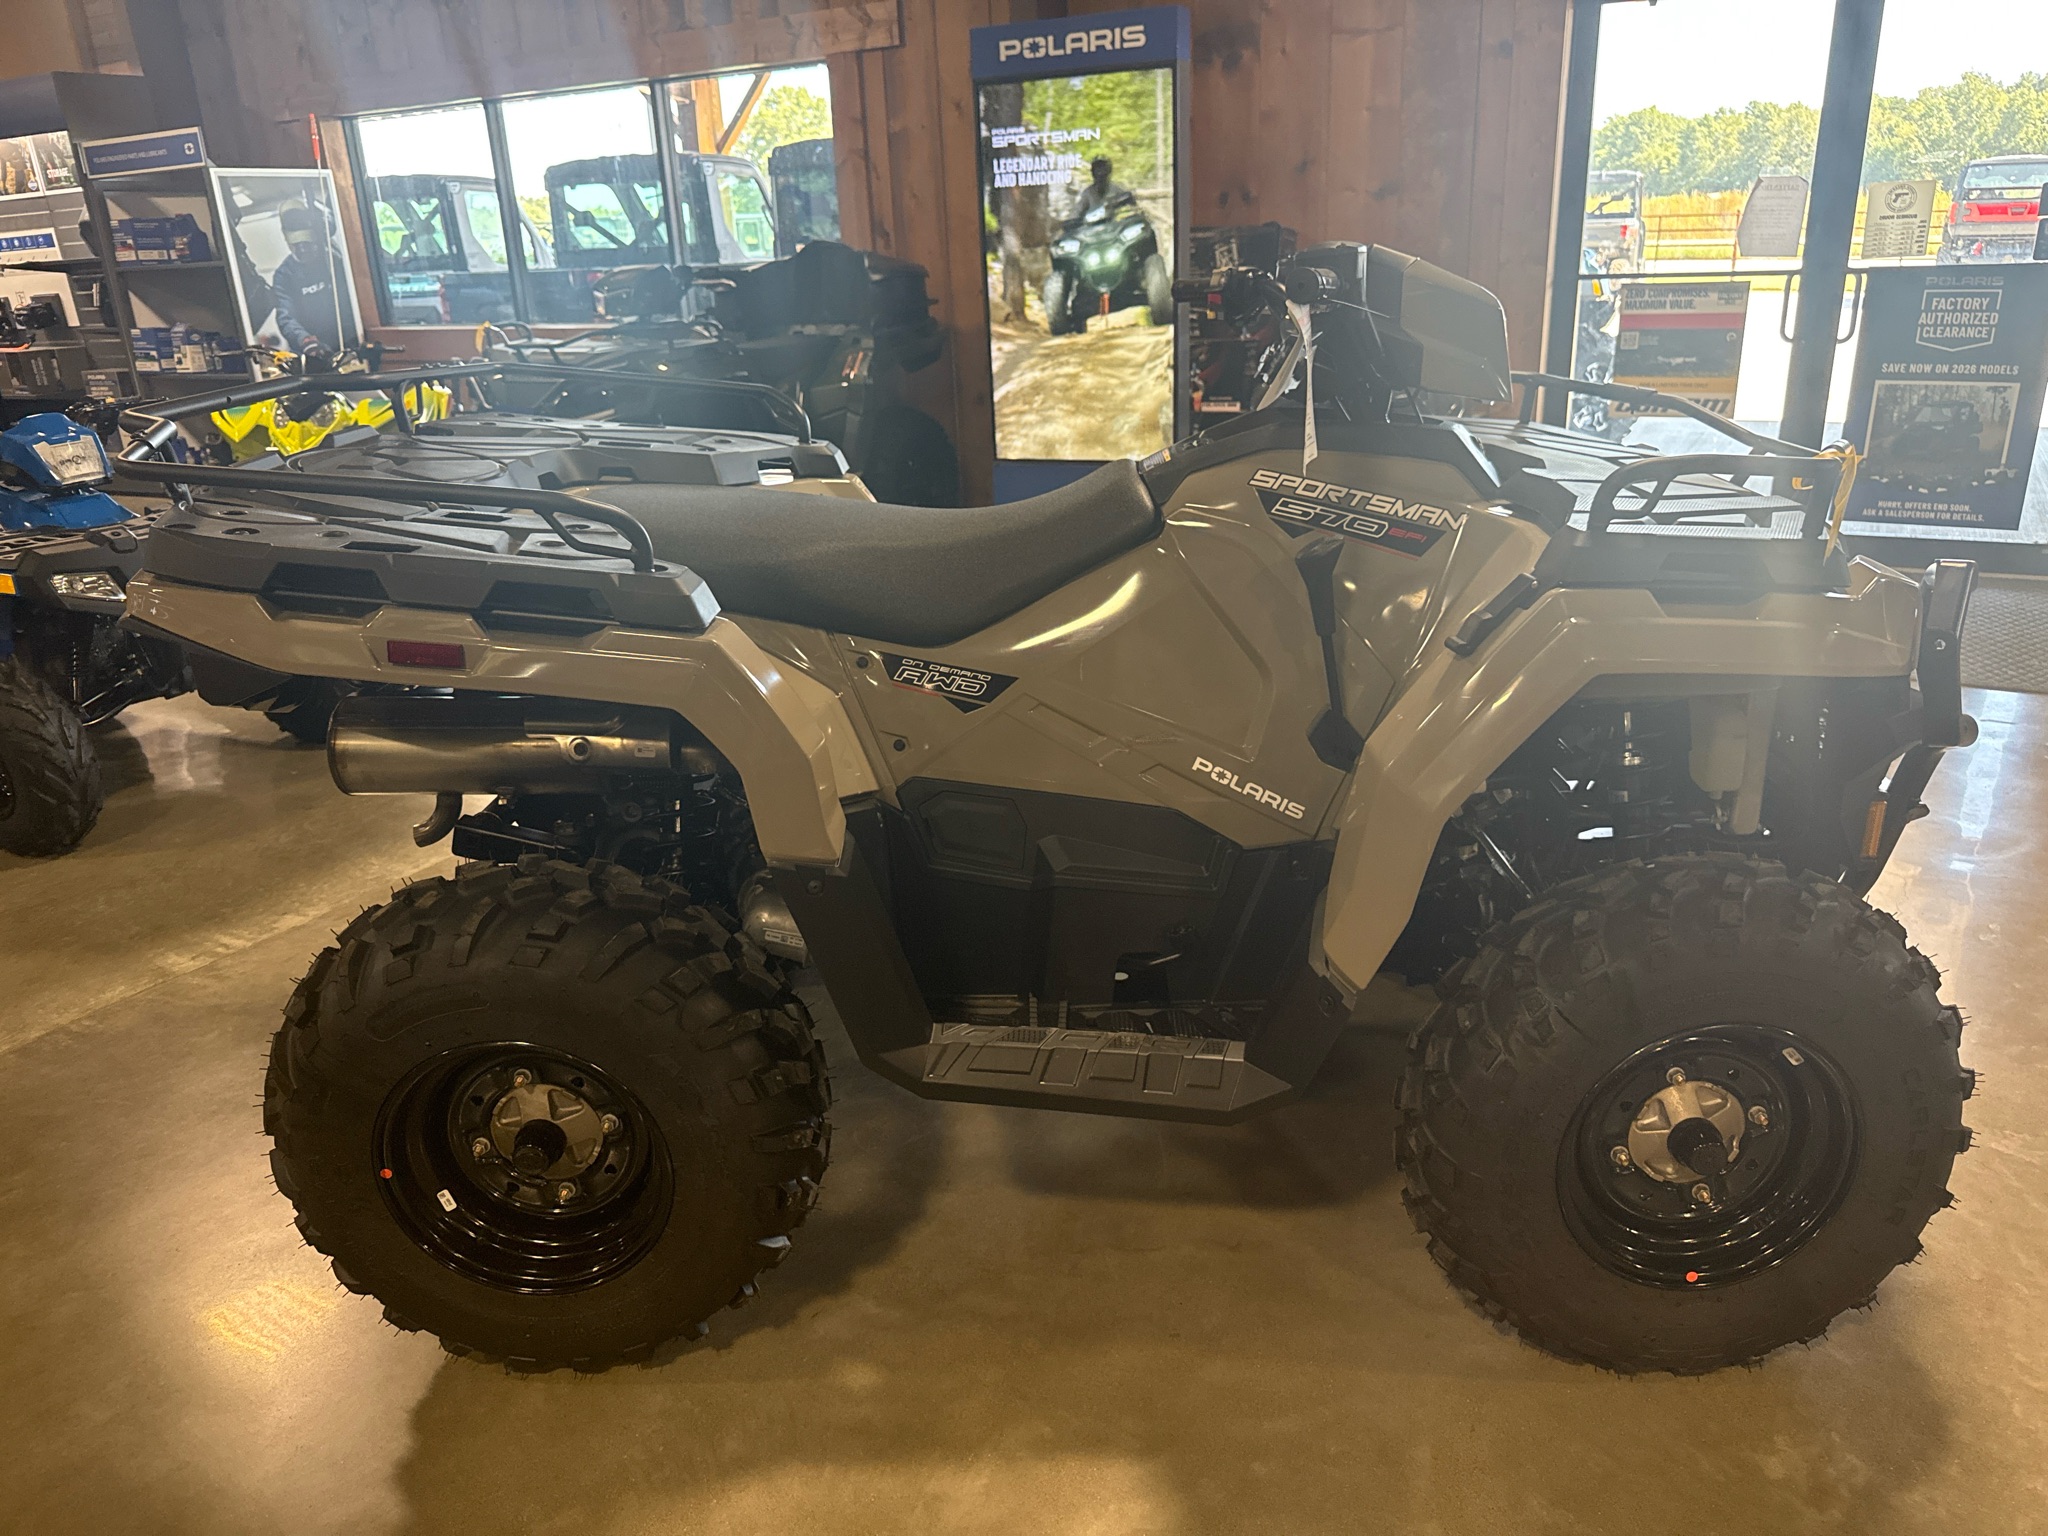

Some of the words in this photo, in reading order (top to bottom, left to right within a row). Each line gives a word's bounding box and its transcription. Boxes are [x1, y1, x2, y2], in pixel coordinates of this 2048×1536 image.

[998, 24, 1147, 62] POLARIS
[991, 127, 1101, 148] SPORTSMAN
[992, 155, 1056, 174] LEGENDARY
[1057, 153, 1083, 169] RIDE
[993, 173, 1017, 188] AND
[1018, 170, 1073, 187] HANDLING
[1925, 276, 2005, 286] POLARIS
[1625, 288, 1646, 298] ZERO
[1648, 288, 1710, 298] COMPROMISES.
[1624, 299, 1667, 311] MAXIMUM
[1669, 299, 1696, 310] VALUE.
[1931, 297, 1990, 310] FACTORY
[1918, 312, 1999, 325] AUTHORIZED
[1922, 326, 1989, 338] CLEARANCE
[1881, 363, 1906, 373] SAVE
[1909, 364, 1932, 374] NOW
[1935, 364, 1949, 374] ON
[1951, 364, 1977, 374] 2026
[1979, 365, 2019, 375] MODELS
[1250, 469, 1468, 531] SPORTSMAN
[1904, 501, 1931, 510] OFFERS
[1933, 502, 1948, 511] END
[1950, 503, 1971, 513] SOON.
[1271, 497, 1389, 539] 570
[1862, 508, 1876, 516] ASK
[1877, 509, 1883, 517] A
[1884, 509, 1935, 519] SALESPERSON
[1936, 511, 1951, 520] FOR
[1952, 512, 1985, 522] DETAILS.
[902, 658, 923, 668] ON
[929, 664, 992, 682] DEMAND
[893, 666, 988, 696] AWD
[1191, 756, 1306, 820] POLARIS
